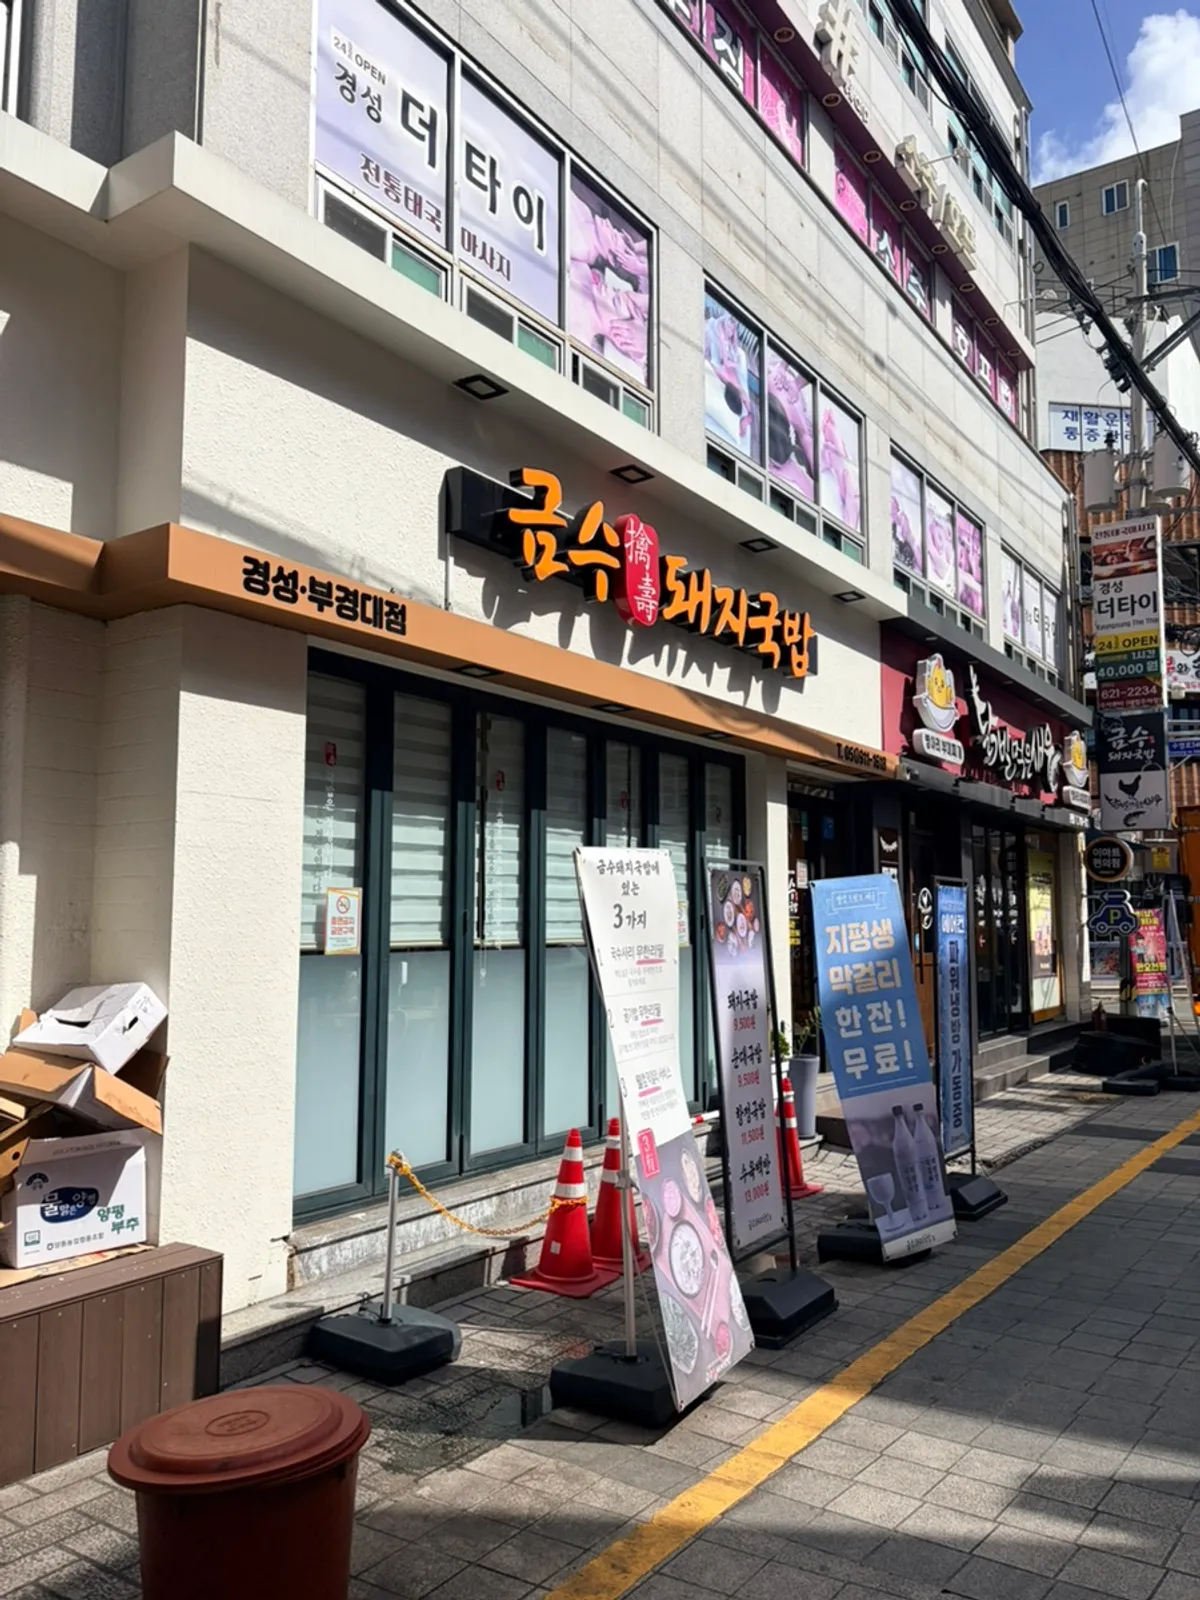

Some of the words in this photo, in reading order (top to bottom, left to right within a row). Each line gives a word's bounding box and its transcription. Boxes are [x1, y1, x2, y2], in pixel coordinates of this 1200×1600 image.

[355, 54, 387, 87] OPEN
[334, 62, 383, 125] 경성
[360, 152, 442, 234] 전통태국
[460, 225, 512, 282] 마사지
[508, 466, 621, 602] 금수
[242, 555, 407, 636] 경성·부경대점
[1100, 580, 1124, 595] 경성
[661, 554, 815, 678] 돼지국밥
[1097, 591, 1158, 619] 더타이
[1122, 635, 1159, 649] OPEN
[1097, 663, 1144, 678] 40,000
[1101, 685, 1158, 701] 621-2234
[1107, 726, 1149, 751] 금수
[1107, 748, 1156, 762] 돼지국밥
[596, 858, 660, 876] 금수돼지국밥에
[621, 880, 640, 897] 있는
[613, 903, 647, 930] 3가지
[1109, 909, 1121, 924] P
[825, 917, 896, 955] 지평생
[828, 958, 903, 995] 막걸리
[727, 988, 759, 1014] 돼지국밥
[733, 1014, 757, 1032] 9,500원
[731, 1043, 763, 1070] 순대국밥
[843, 1040, 914, 1080] 무료!
[739, 1153, 772, 1184] 수육백반
[97, 1203, 126, 1223] 양평
